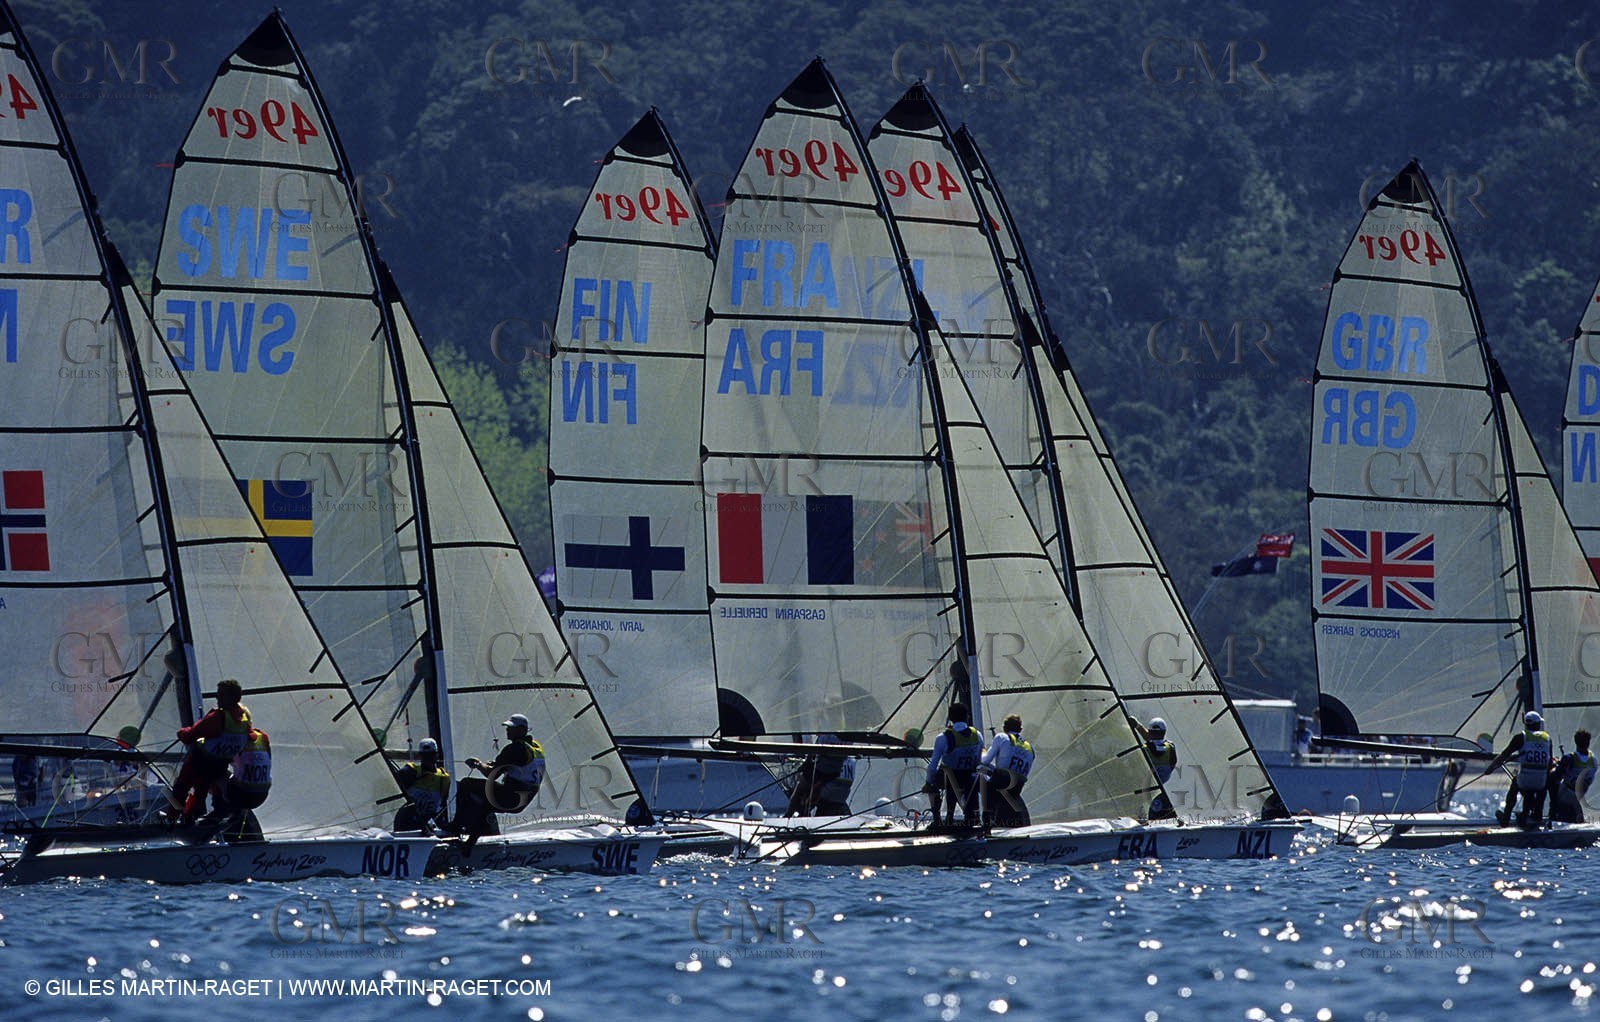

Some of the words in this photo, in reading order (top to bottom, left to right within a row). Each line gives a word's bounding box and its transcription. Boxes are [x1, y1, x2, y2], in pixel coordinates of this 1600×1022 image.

[176, 203, 312, 281] SWE
[731, 239, 840, 309] FRA
[572, 278, 652, 345] FIN
[1331, 311, 1429, 374] GBR
[1525, 750, 1548, 764] GBR
[251, 851, 298, 875] Sydney
[362, 843, 410, 878] NOR
[591, 842, 640, 875] SWE
[1117, 833, 1158, 860] FRA
